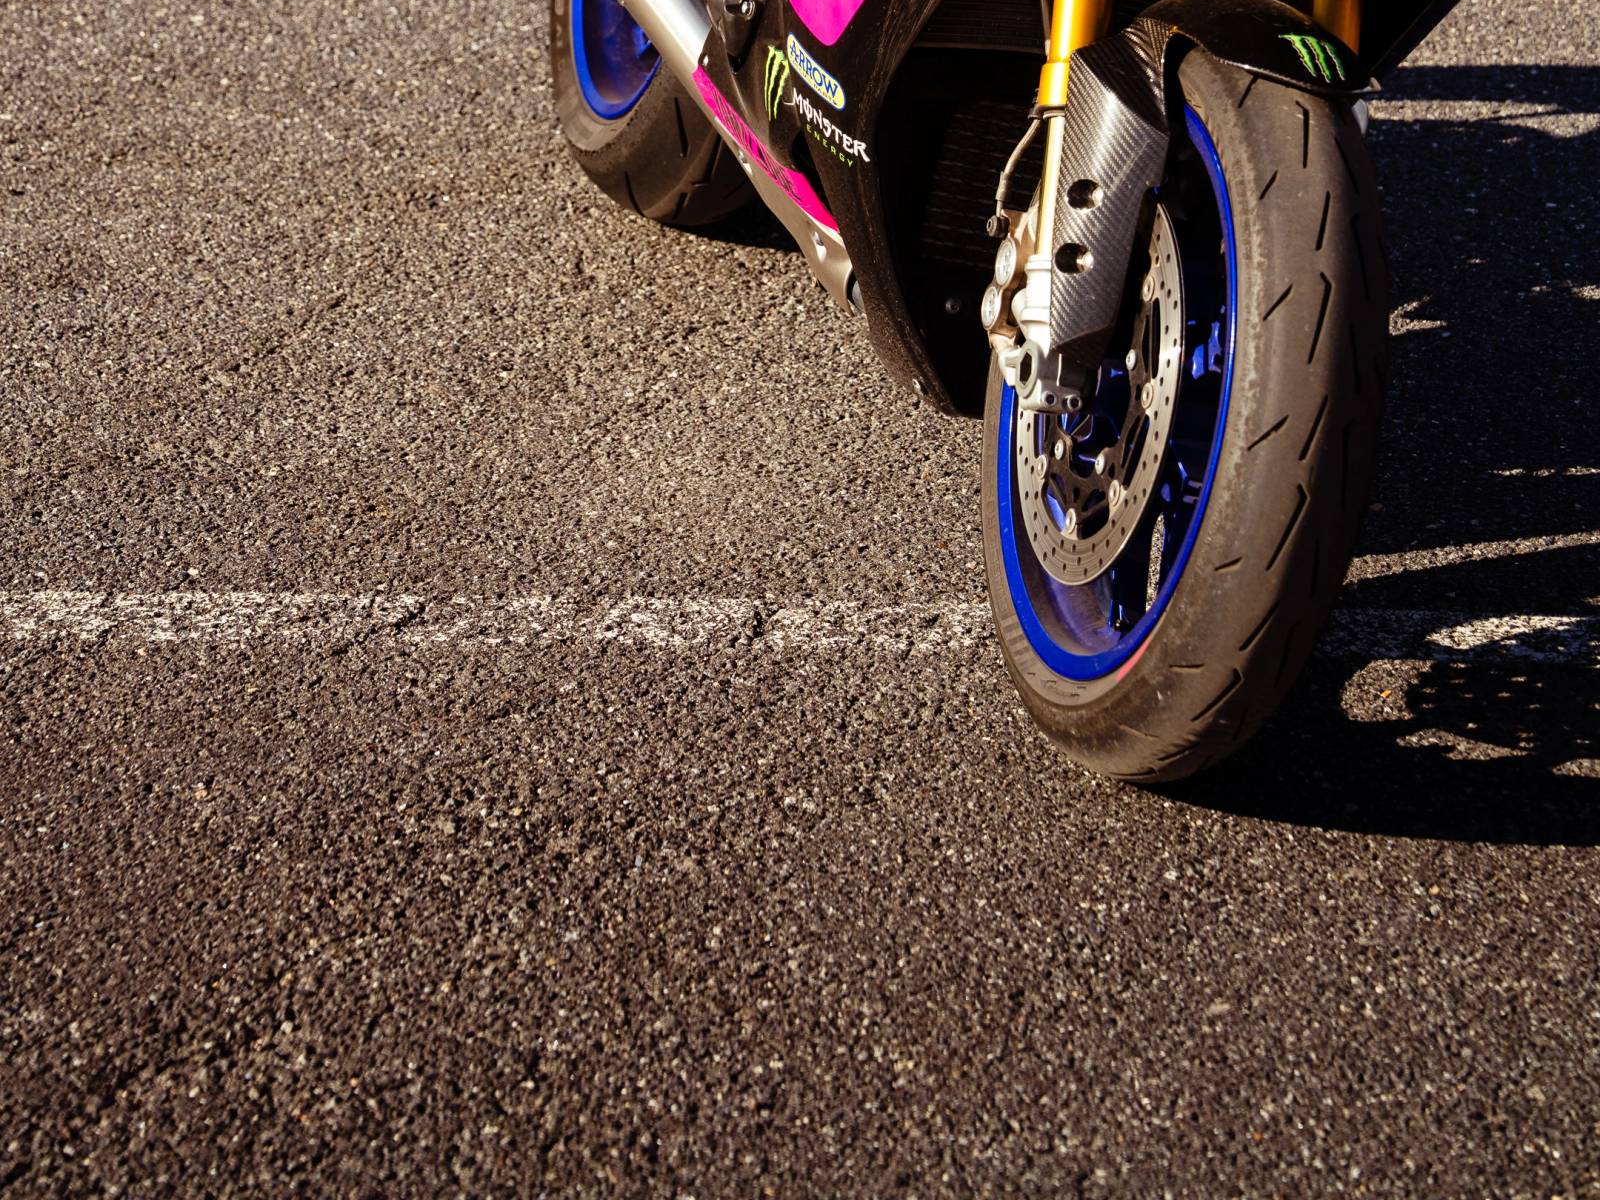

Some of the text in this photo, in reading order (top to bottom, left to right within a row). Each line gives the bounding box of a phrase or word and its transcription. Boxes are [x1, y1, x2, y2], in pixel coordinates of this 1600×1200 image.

[789, 40, 839, 99] ARROW
[783, 87, 871, 163] MONSTER
[806, 123, 854, 168] ENERGY
